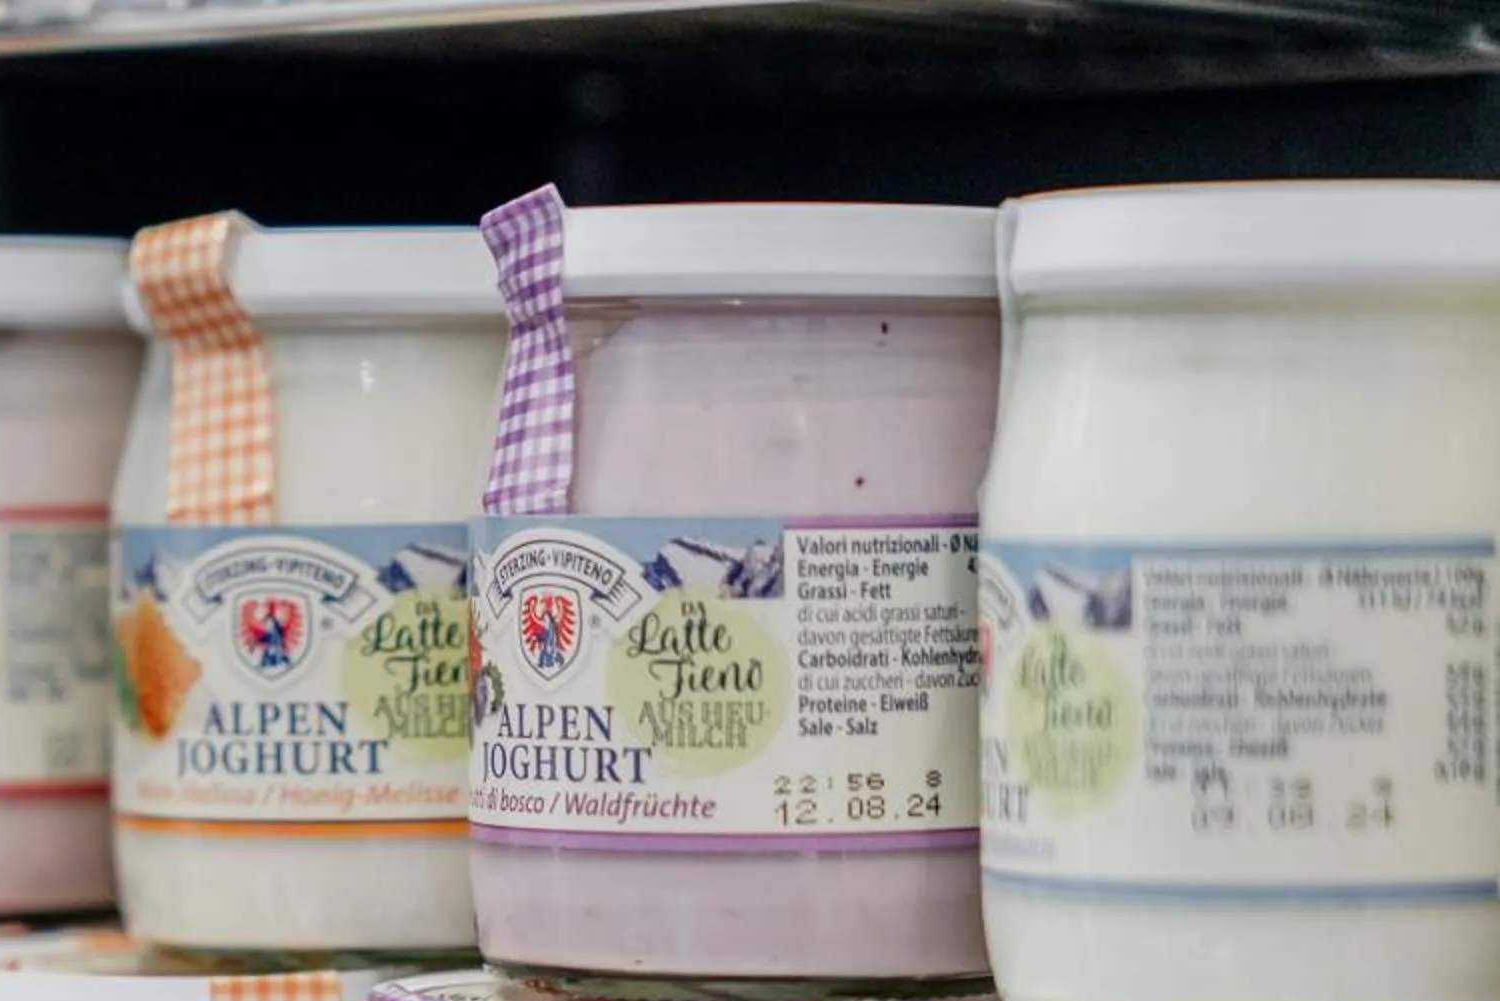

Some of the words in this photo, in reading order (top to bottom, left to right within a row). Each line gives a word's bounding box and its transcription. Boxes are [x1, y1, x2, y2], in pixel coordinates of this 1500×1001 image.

[796, 535, 848, 554] Valori
[851, 534, 940, 555] nutrizionali
[797, 559, 860, 581] Energia
[872, 557, 930, 581] Energie
[797, 582, 848, 601] Grassi
[860, 581, 892, 600] Fett
[797, 606, 813, 623] di
[815, 606, 840, 623] cui
[842, 604, 878, 623] acidi
[880, 604, 921, 627] grassi
[360, 612, 464, 657] Latte
[626, 612, 732, 658] Latte
[797, 628, 845, 647] davon
[797, 650, 890, 669] Carboidrati
[798, 672, 813, 691] di
[816, 672, 841, 691] cui
[842, 671, 904, 691] zuccheri
[915, 670, 955, 690] davon
[638, 701, 694, 725] AUS
[798, 694, 868, 714] Proteine
[879, 691, 930, 713] Eiweiß
[203, 701, 349, 737] ALPEN
[497, 703, 615, 742] ALPEN
[798, 718, 834, 737] Sale
[845, 716, 879, 735] Salz
[651, 716, 748, 748] MILCH
[177, 738, 389, 778] JOGHURT
[483, 742, 653, 784] JOGHURT
[501, 788, 545, 814] bosco
[565, 792, 717, 824] Waldfrüchte
